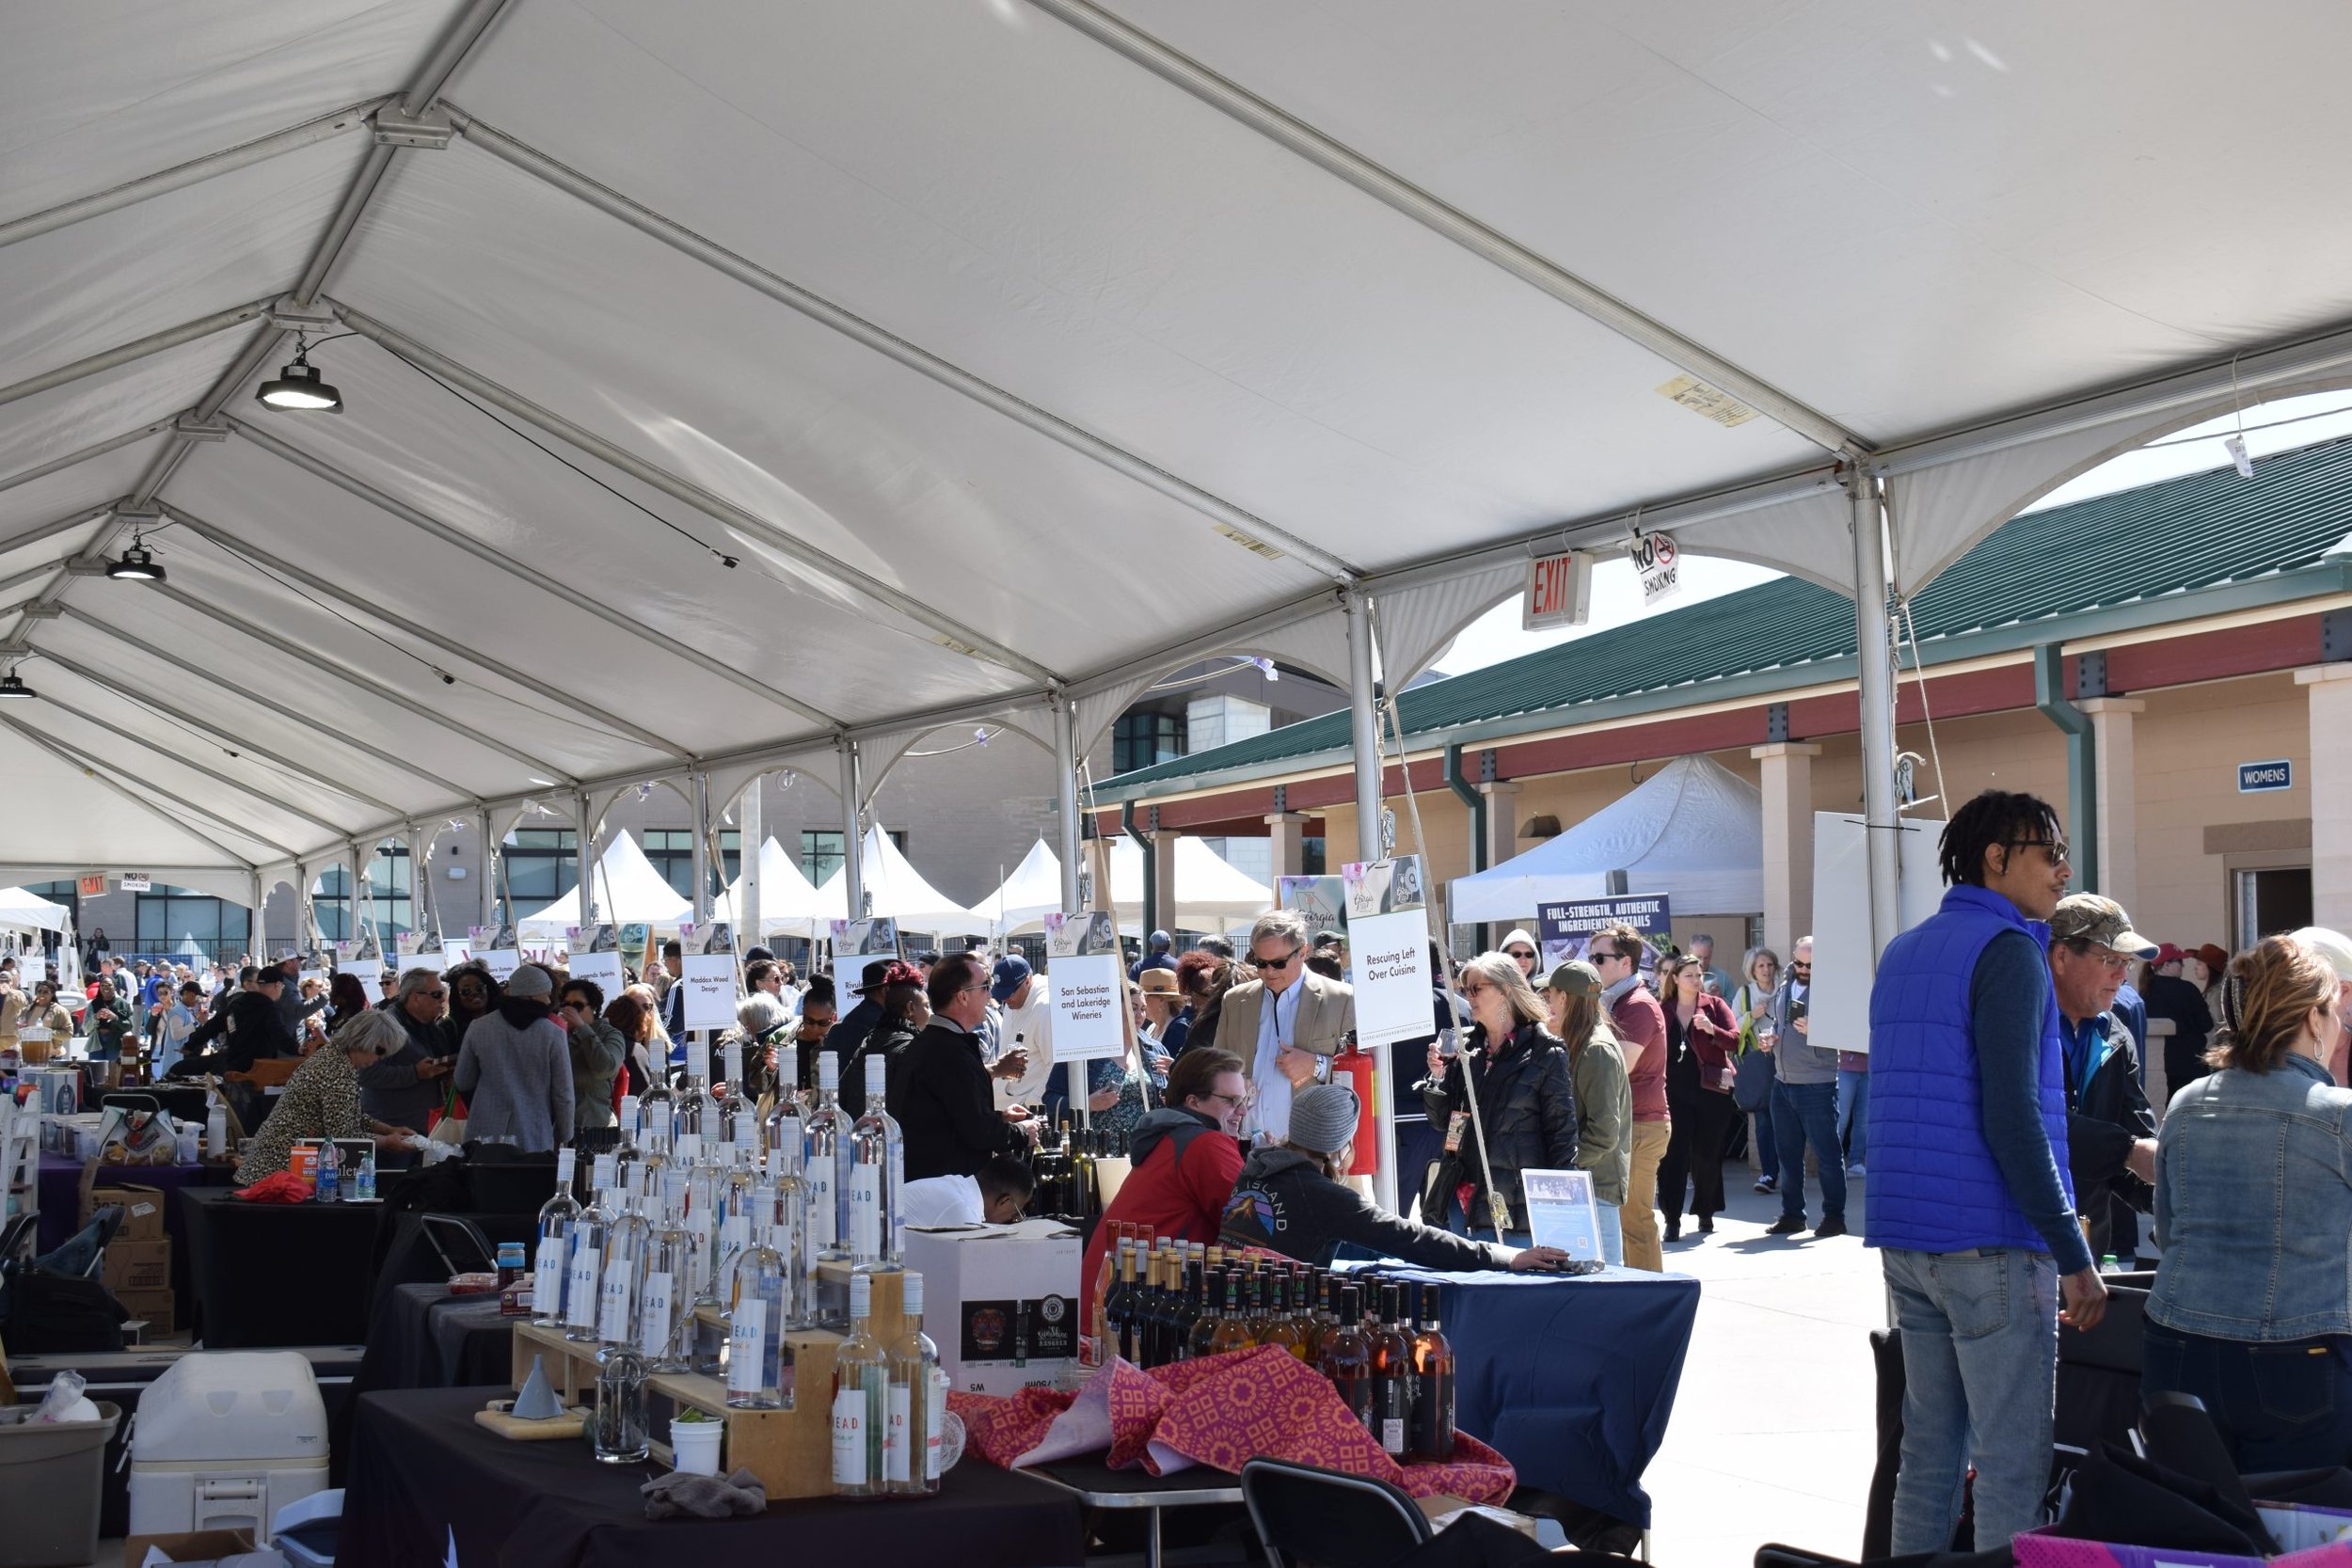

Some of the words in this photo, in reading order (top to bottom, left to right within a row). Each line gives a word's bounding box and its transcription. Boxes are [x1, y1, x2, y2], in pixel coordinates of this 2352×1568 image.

[1533, 556, 1571, 614] EXIT
[1644, 567, 1676, 596] SMOKING
[2244, 768, 2285, 784] WOMENS
[82, 875, 103, 894] EXIT
[1547, 903, 1613, 920] FULL-STRENGTH,
[1615, 900, 1661, 916] AUTHENTIC
[1366, 950, 1400, 966] Rescuing
[1402, 947, 1415, 960] Left
[1368, 969, 1388, 981] Over
[1389, 965, 1416, 978] Cuisine
[701, 986, 719, 994] Design
[845, 981, 864, 990] Rivule
[1061, 988, 1075, 997] San
[1076, 985, 1110, 995] Sebastian
[1061, 999, 1075, 1009] and
[1076, 996, 1111, 1009] Lakeridge
[1072, 1010, 1102, 1021] Wineries
[1247, 1180, 1287, 1231] ISLAND
